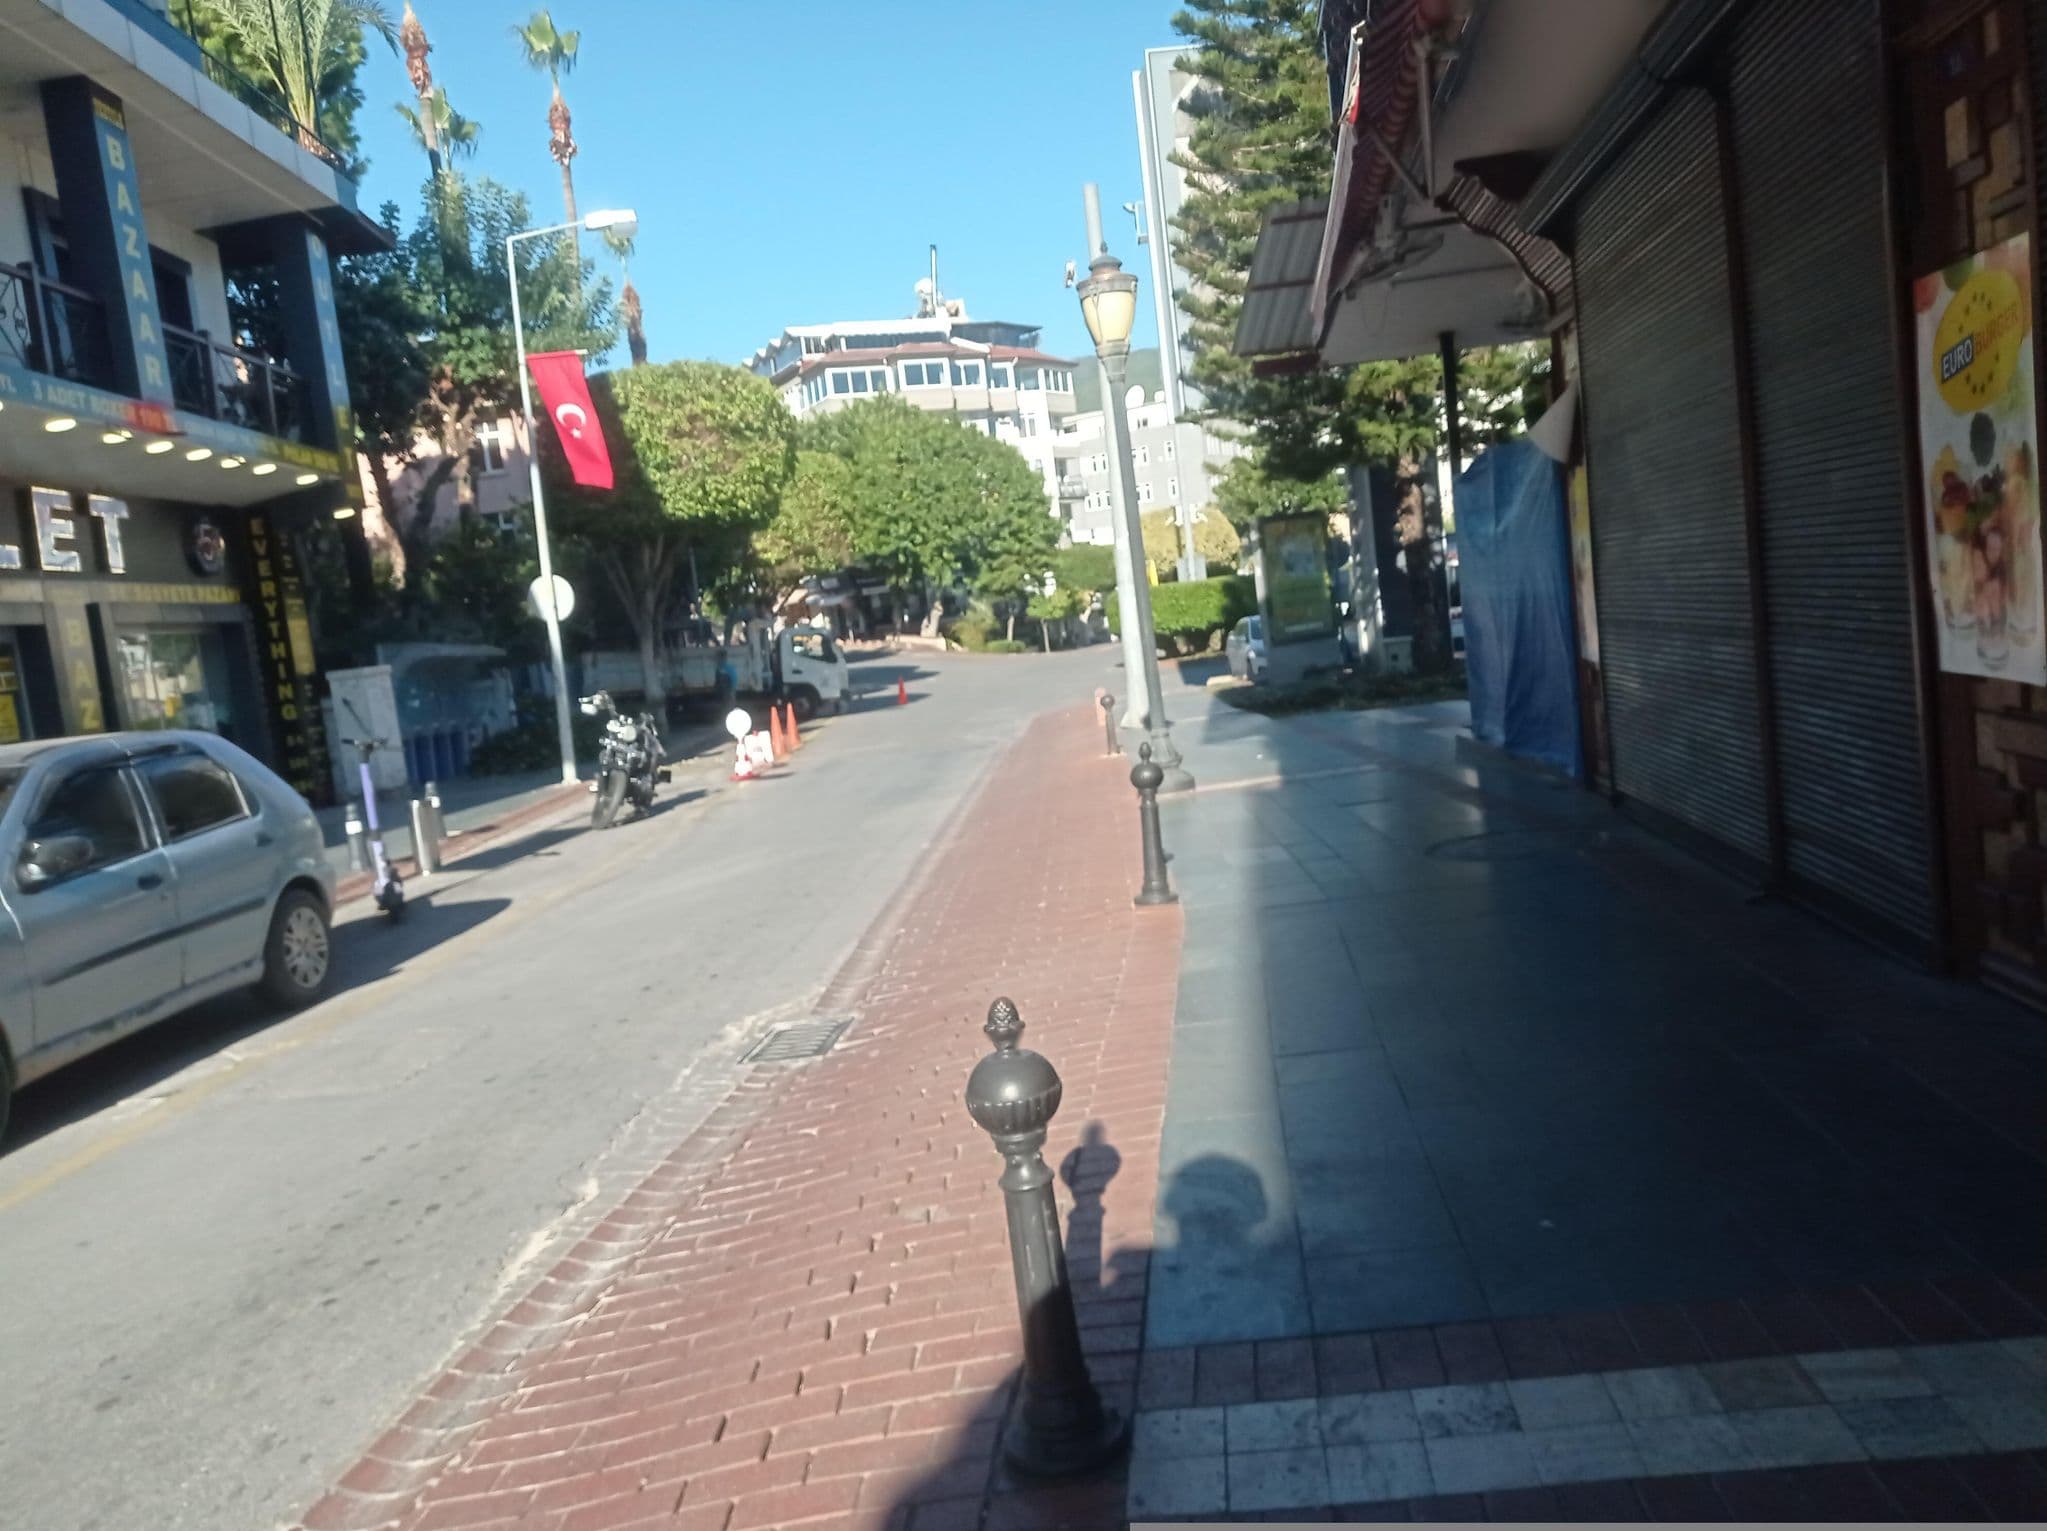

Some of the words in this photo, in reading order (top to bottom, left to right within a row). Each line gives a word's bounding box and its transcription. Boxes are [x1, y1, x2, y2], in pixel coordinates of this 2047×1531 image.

[105, 134, 163, 387] BAZAAR
[1942, 338, 1974, 380] EURO
[250, 517, 298, 721] EVERYTHING
